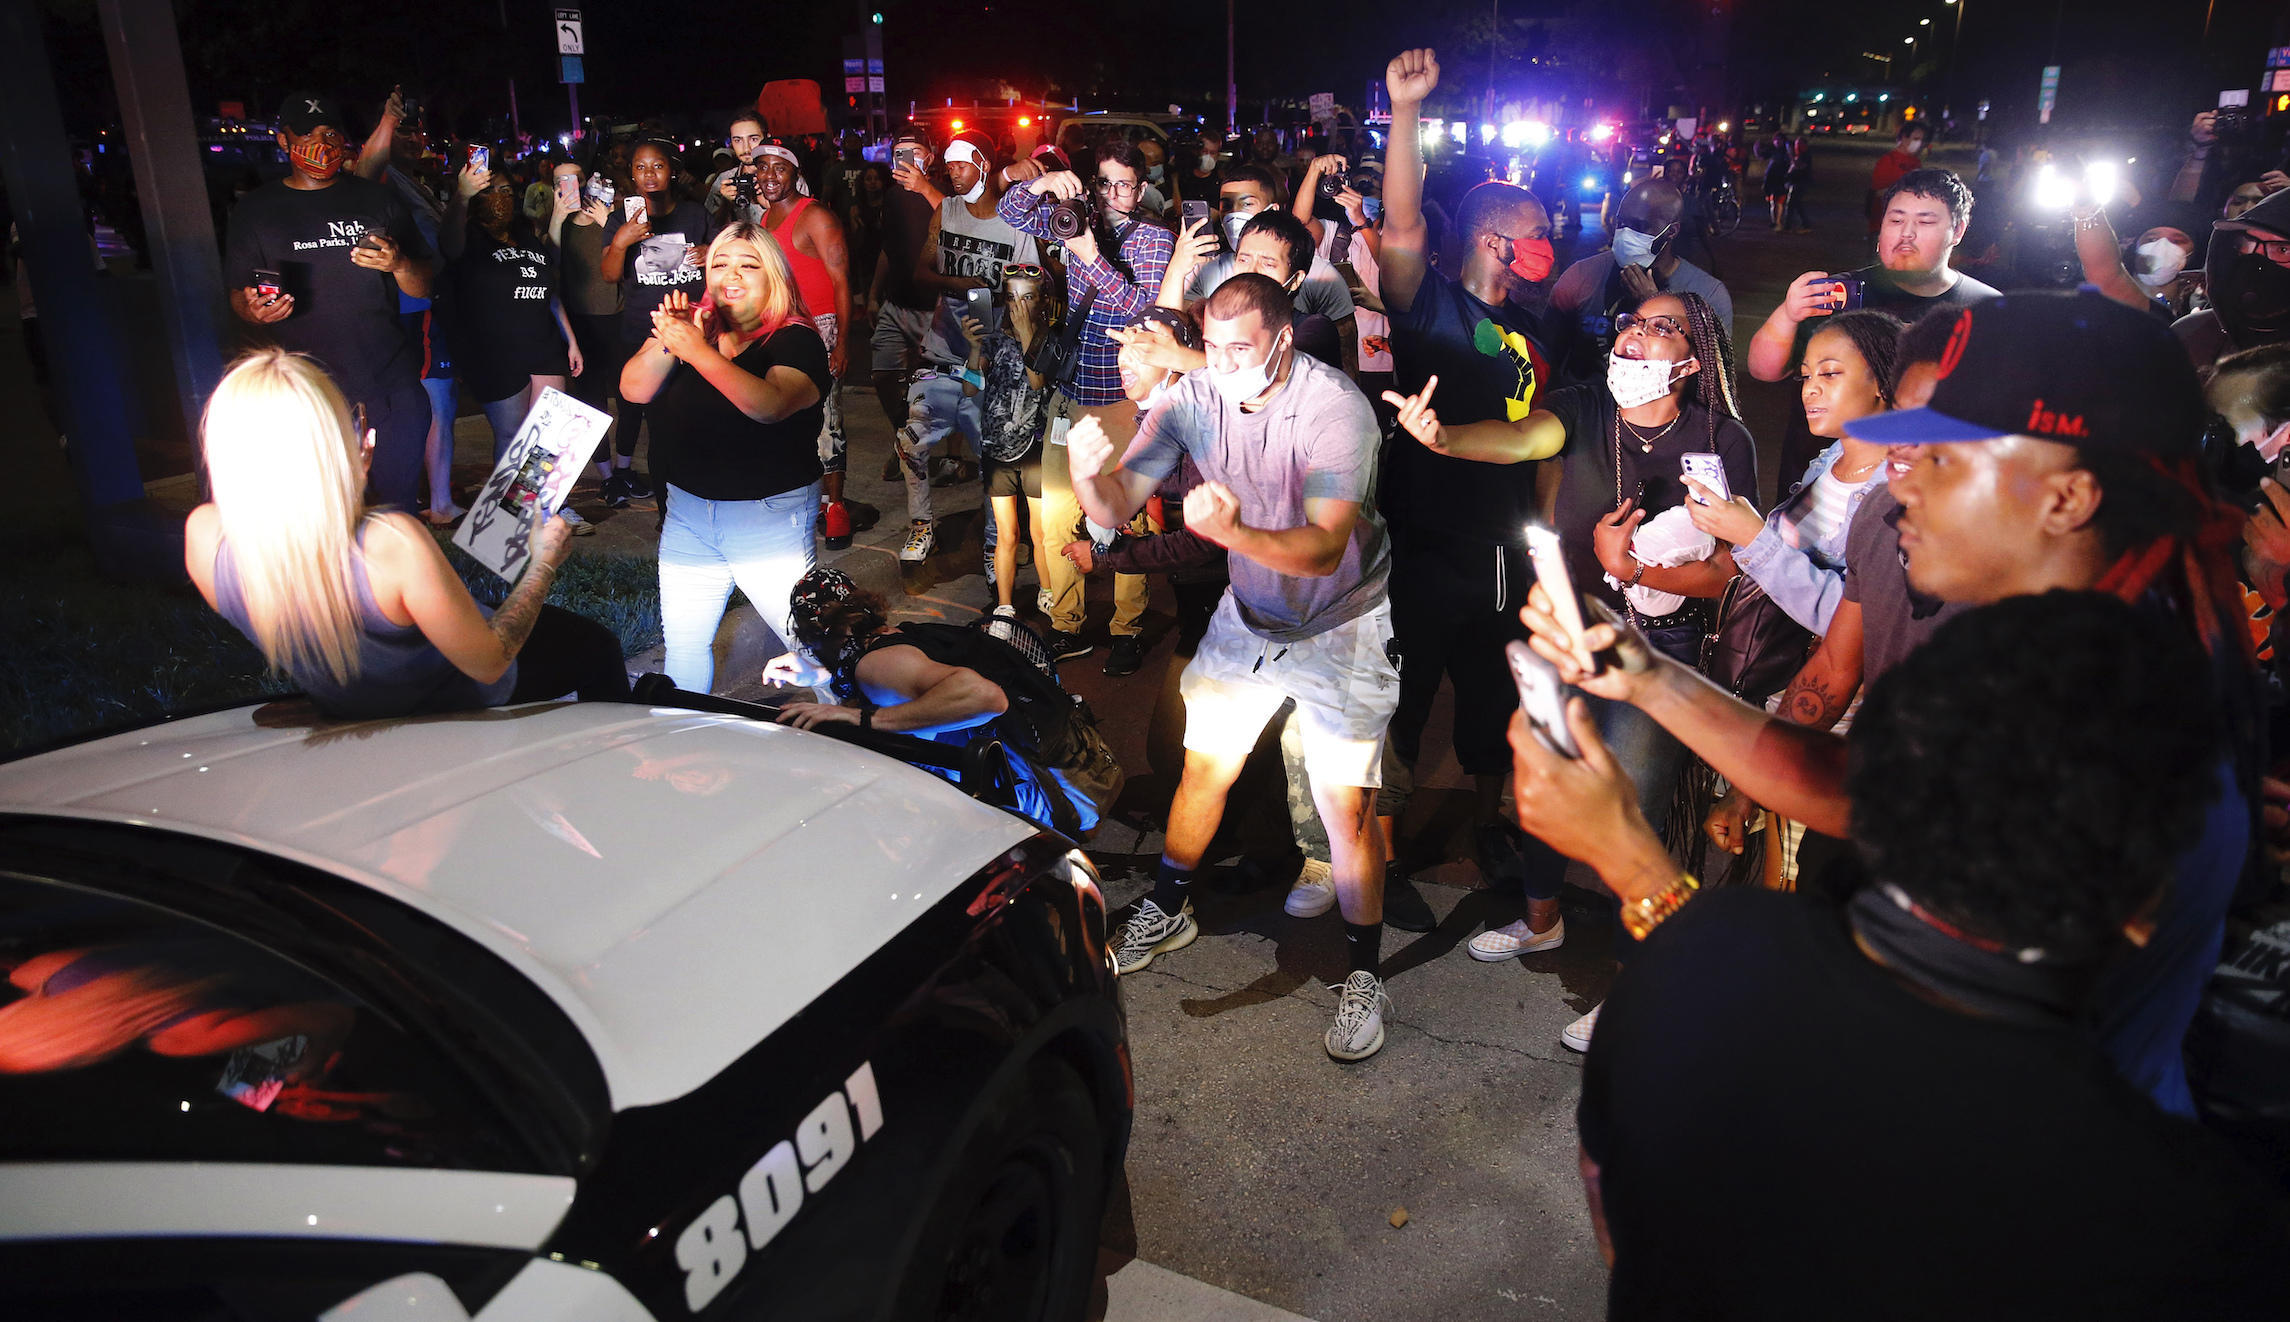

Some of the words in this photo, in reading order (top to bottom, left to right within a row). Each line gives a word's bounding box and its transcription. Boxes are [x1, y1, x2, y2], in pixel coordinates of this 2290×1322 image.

[562, 44, 580, 52] ONLY
[304, 99, 324, 114] X
[293, 240, 318, 251] Rosa
[319, 236, 350, 249] Parks,
[519, 266, 539, 279] AS
[513, 286, 548, 300] FUCK
[675, 1060, 884, 1314] 8091
